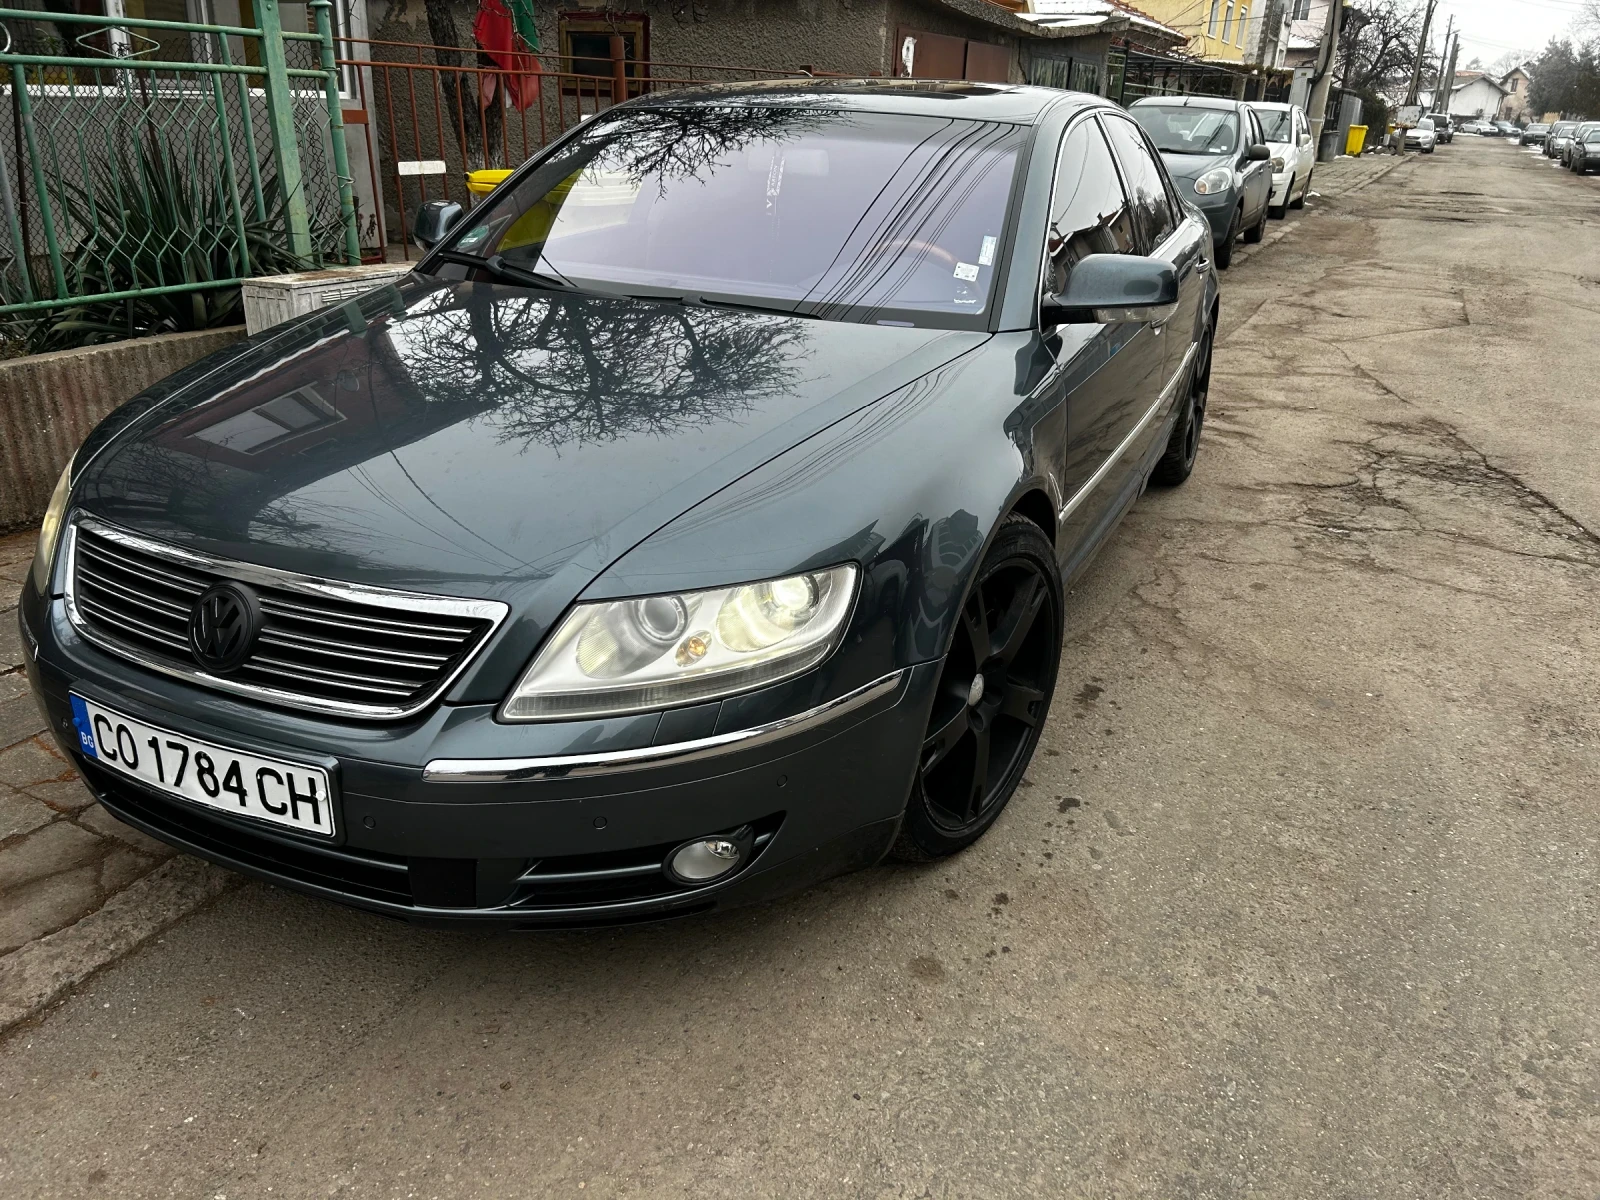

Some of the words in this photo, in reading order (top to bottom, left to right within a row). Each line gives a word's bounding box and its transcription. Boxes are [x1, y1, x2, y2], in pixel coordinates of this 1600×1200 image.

[80, 731, 95, 749] BG
[93, 713, 139, 770] CO
[147, 735, 248, 807] 1784
[255, 766, 322, 826] CH
